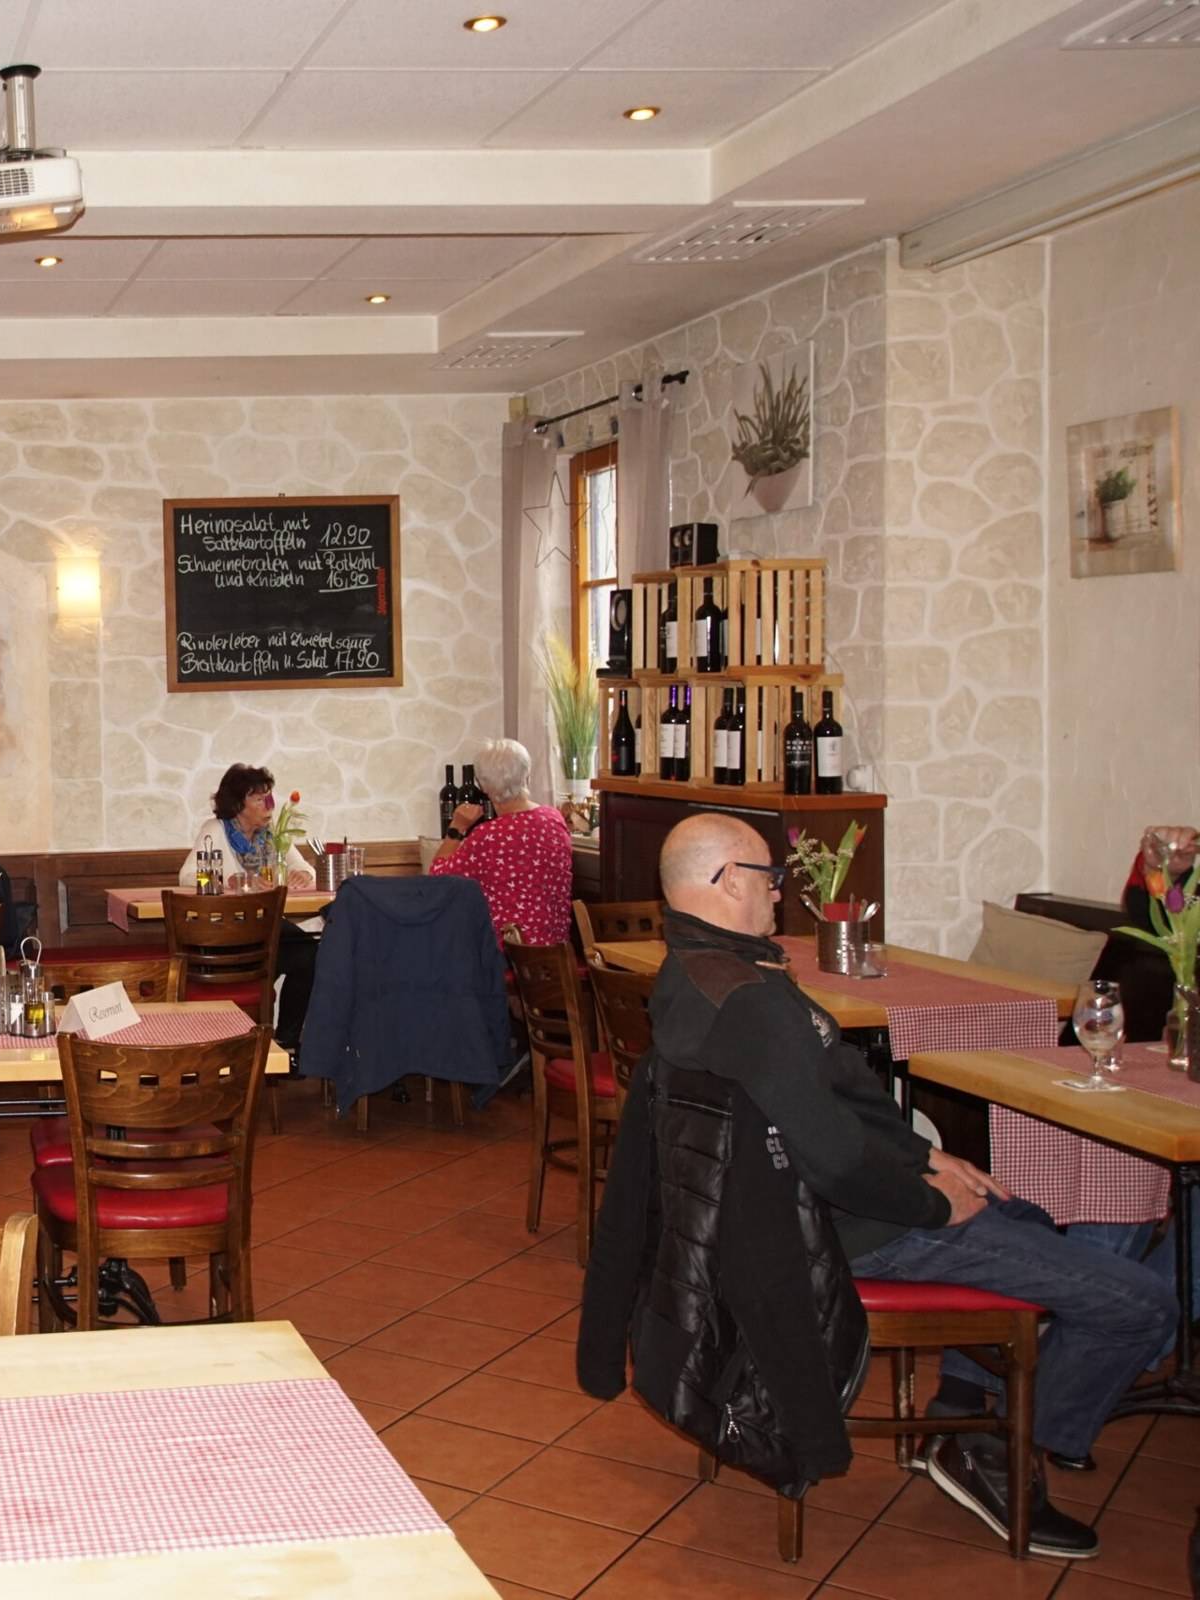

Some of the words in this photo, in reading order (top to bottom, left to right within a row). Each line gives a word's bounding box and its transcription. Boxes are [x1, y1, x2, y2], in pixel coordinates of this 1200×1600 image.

[283, 512, 311, 531] mit
[320, 522, 371, 547] 12,90
[177, 551, 289, 574] Schweinebraten
[298, 552, 323, 570] mit
[323, 551, 380, 572] Rotkohl
[326, 570, 369, 588] 16,90
[177, 631, 261, 651] Rinderleber
[268, 631, 287, 647] mit
[335, 650, 379, 670] 17,90
